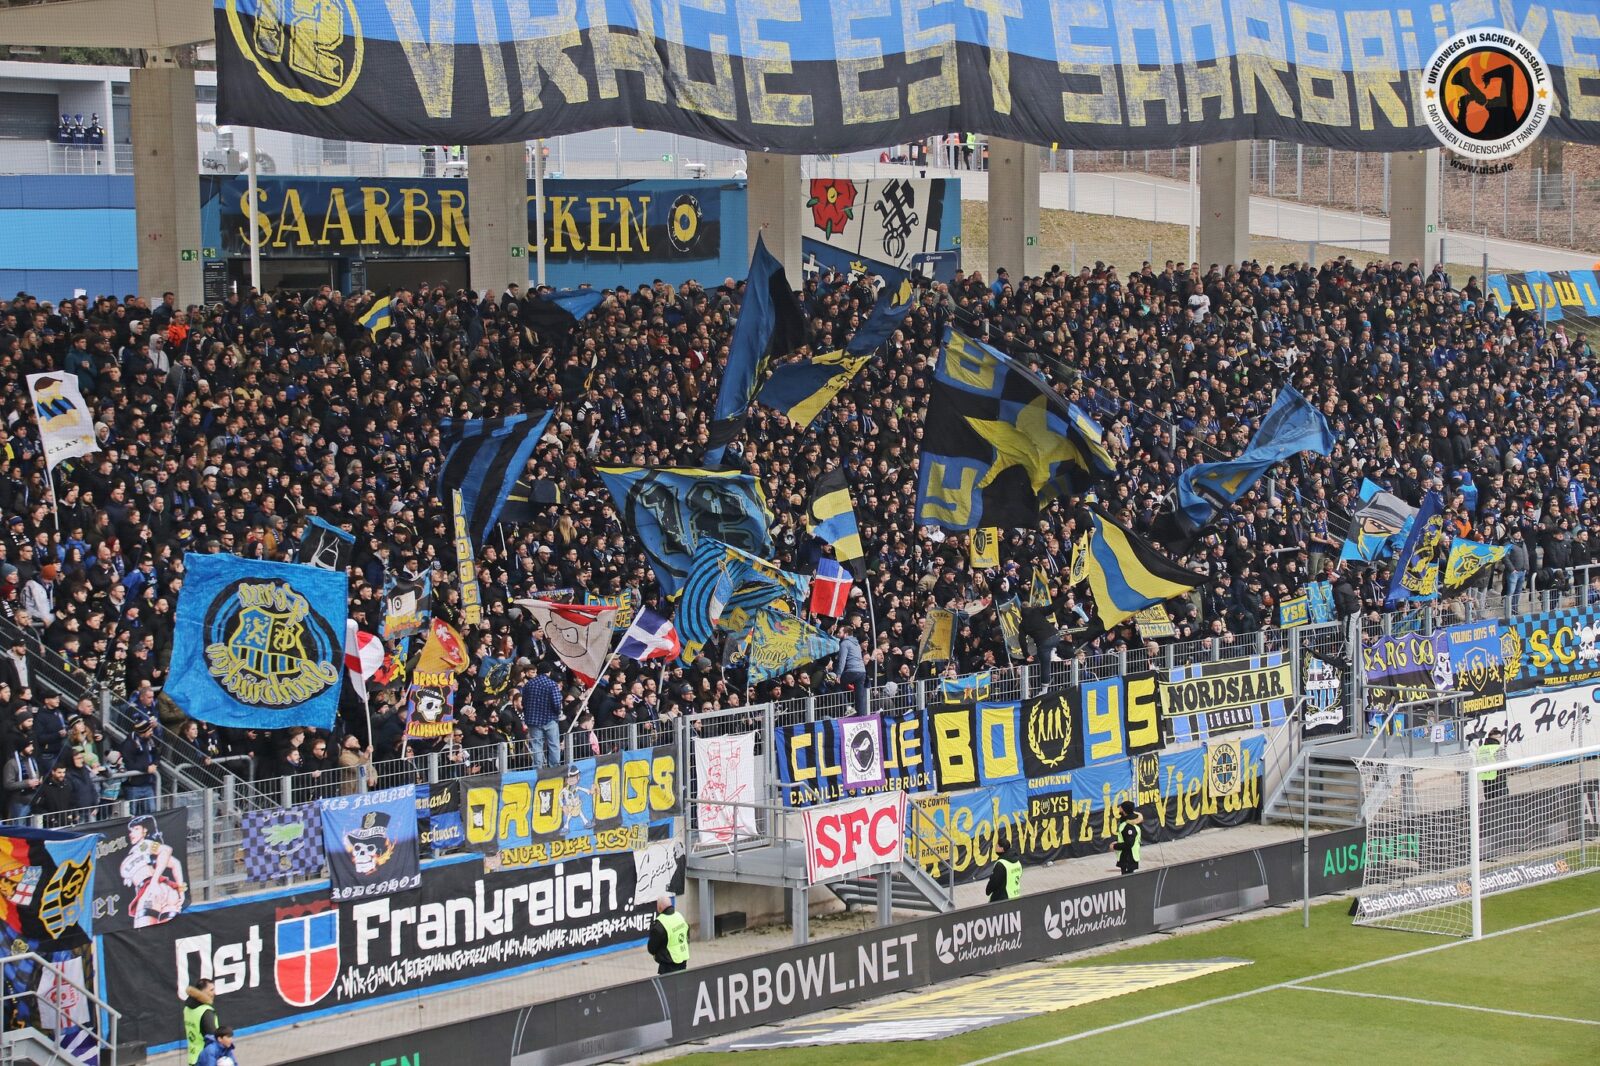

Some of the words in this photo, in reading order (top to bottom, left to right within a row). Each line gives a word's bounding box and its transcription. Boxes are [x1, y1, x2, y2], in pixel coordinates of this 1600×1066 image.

[385, 0, 814, 127] VIRAGE
[832, 0, 1024, 127] EST
[239, 185, 651, 252] SAARBRKEN
[1282, 603, 1307, 622] YSB
[1450, 630, 1472, 645] YOUNG
[1473, 628, 1487, 642] BOYS
[1530, 627, 1577, 668] SC
[1168, 671, 1285, 713] NORDSAAR
[466, 755, 676, 844] DROOGS
[1032, 796, 1069, 817] BOYS
[1139, 788, 1160, 806] BOYS
[502, 845, 548, 866] NUR
[550, 836, 591, 860] DER
[594, 827, 629, 851] FCS
[815, 804, 898, 869] SFC
[1323, 832, 1420, 878] AUSATMEN
[1360, 889, 1417, 914] Eisenbach
[1469, 866, 1519, 891] isenbach
[353, 857, 619, 966] Frankreich
[1066, 907, 1127, 939] international
[958, 930, 1022, 963] international
[692, 933, 918, 1026] AIRBOWL.NET
